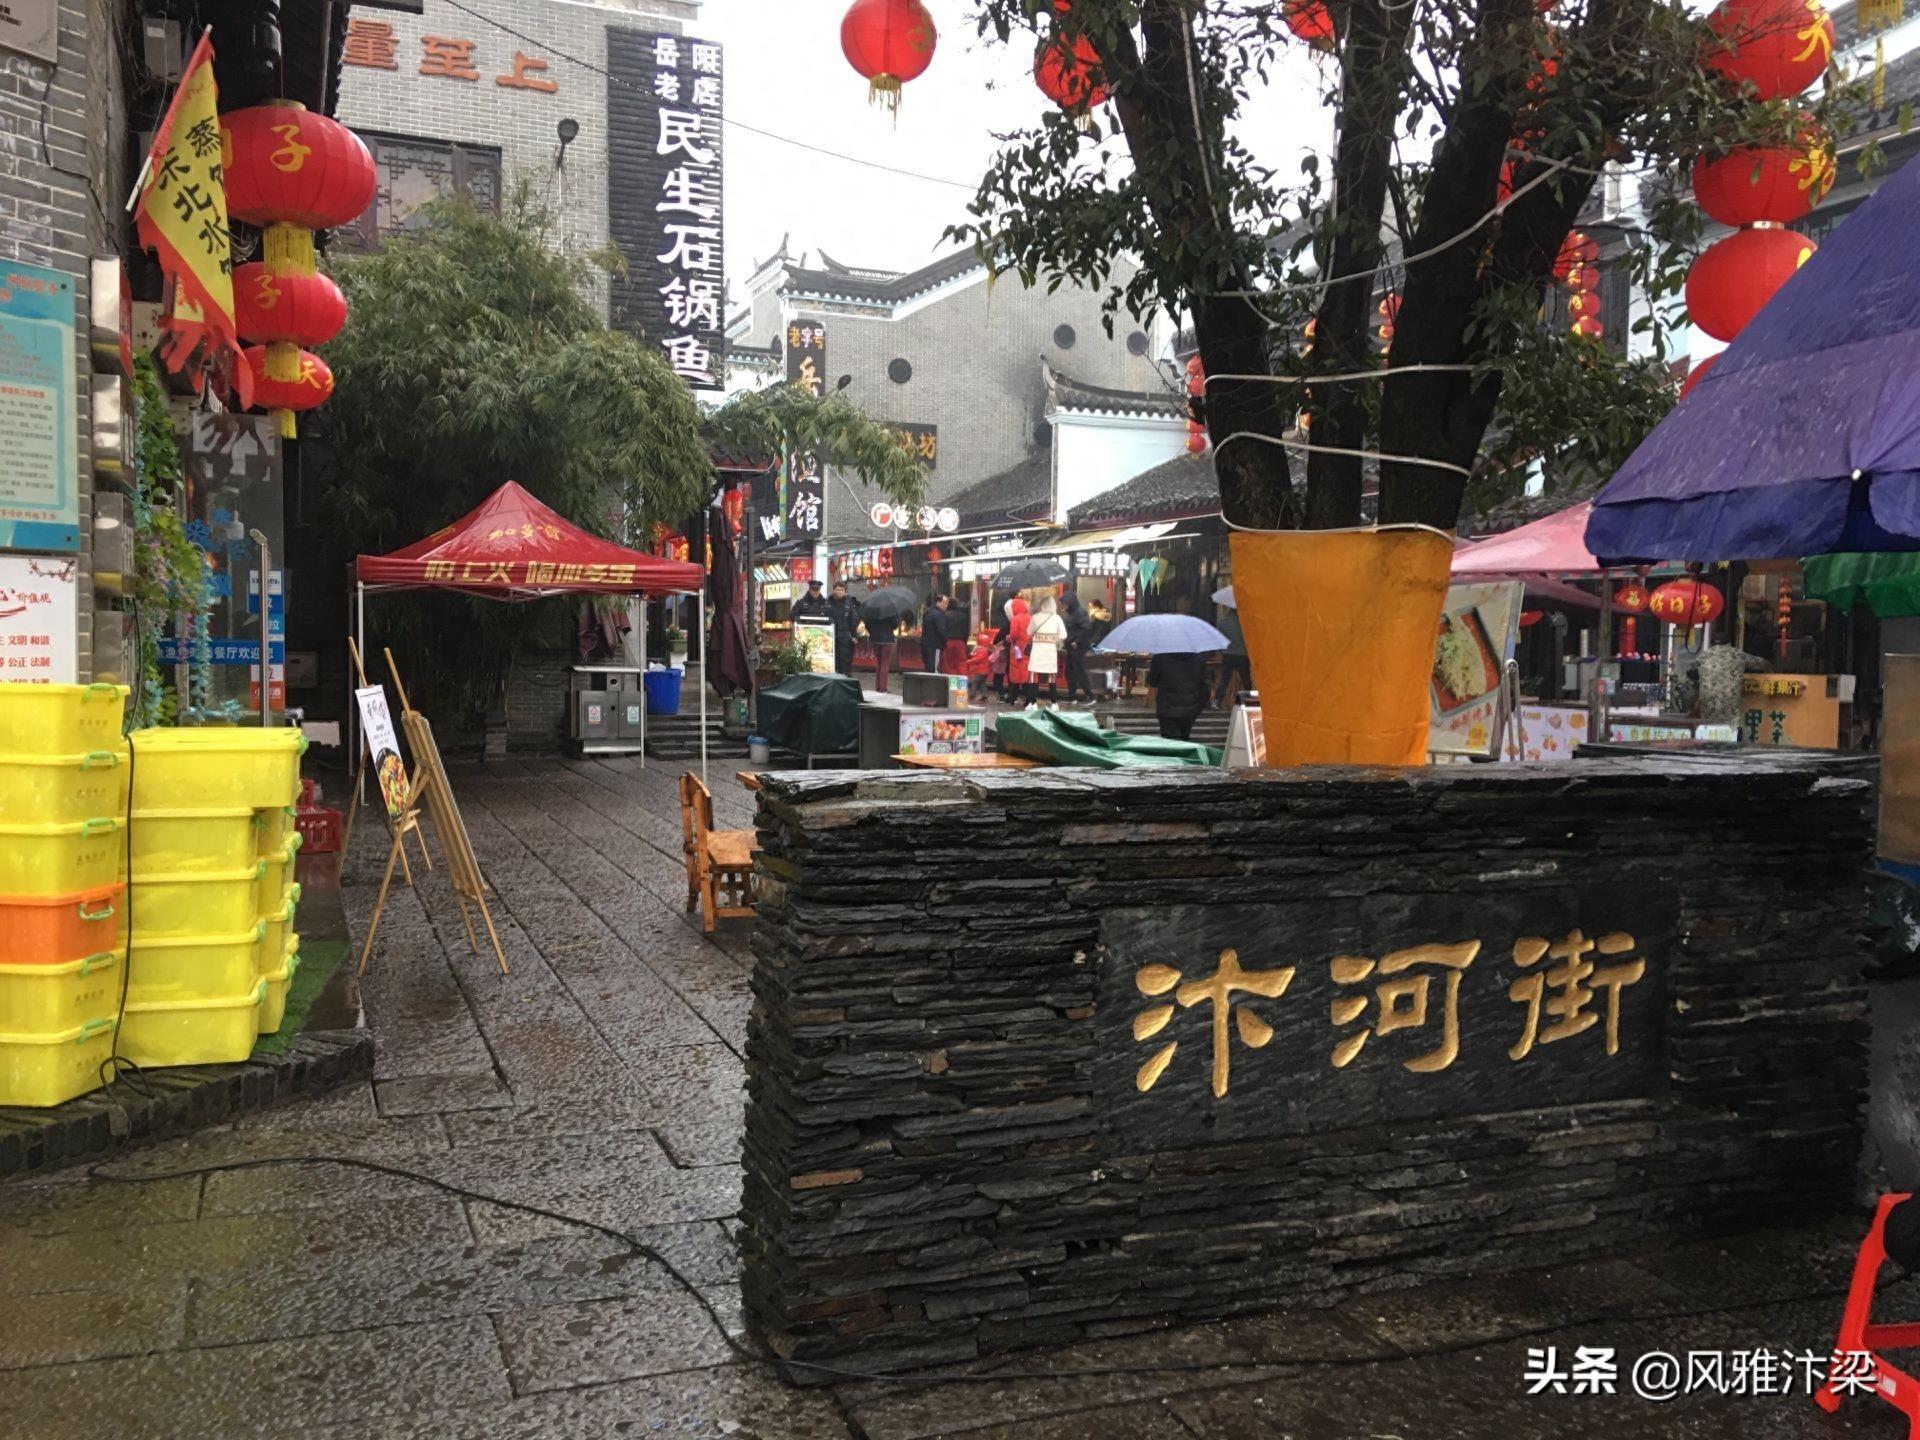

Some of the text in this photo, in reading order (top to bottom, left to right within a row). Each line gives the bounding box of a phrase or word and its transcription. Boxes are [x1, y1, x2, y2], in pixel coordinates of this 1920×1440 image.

[656, 107, 720, 386] 民生石锅鱼
[789, 326, 825, 350] 老字号
[8, 634, 28, 646] 文明
[30, 635, 50, 646] 和谐
[8, 656, 28, 667] 公正
[1133, 928, 1646, 1098] 汴河街
